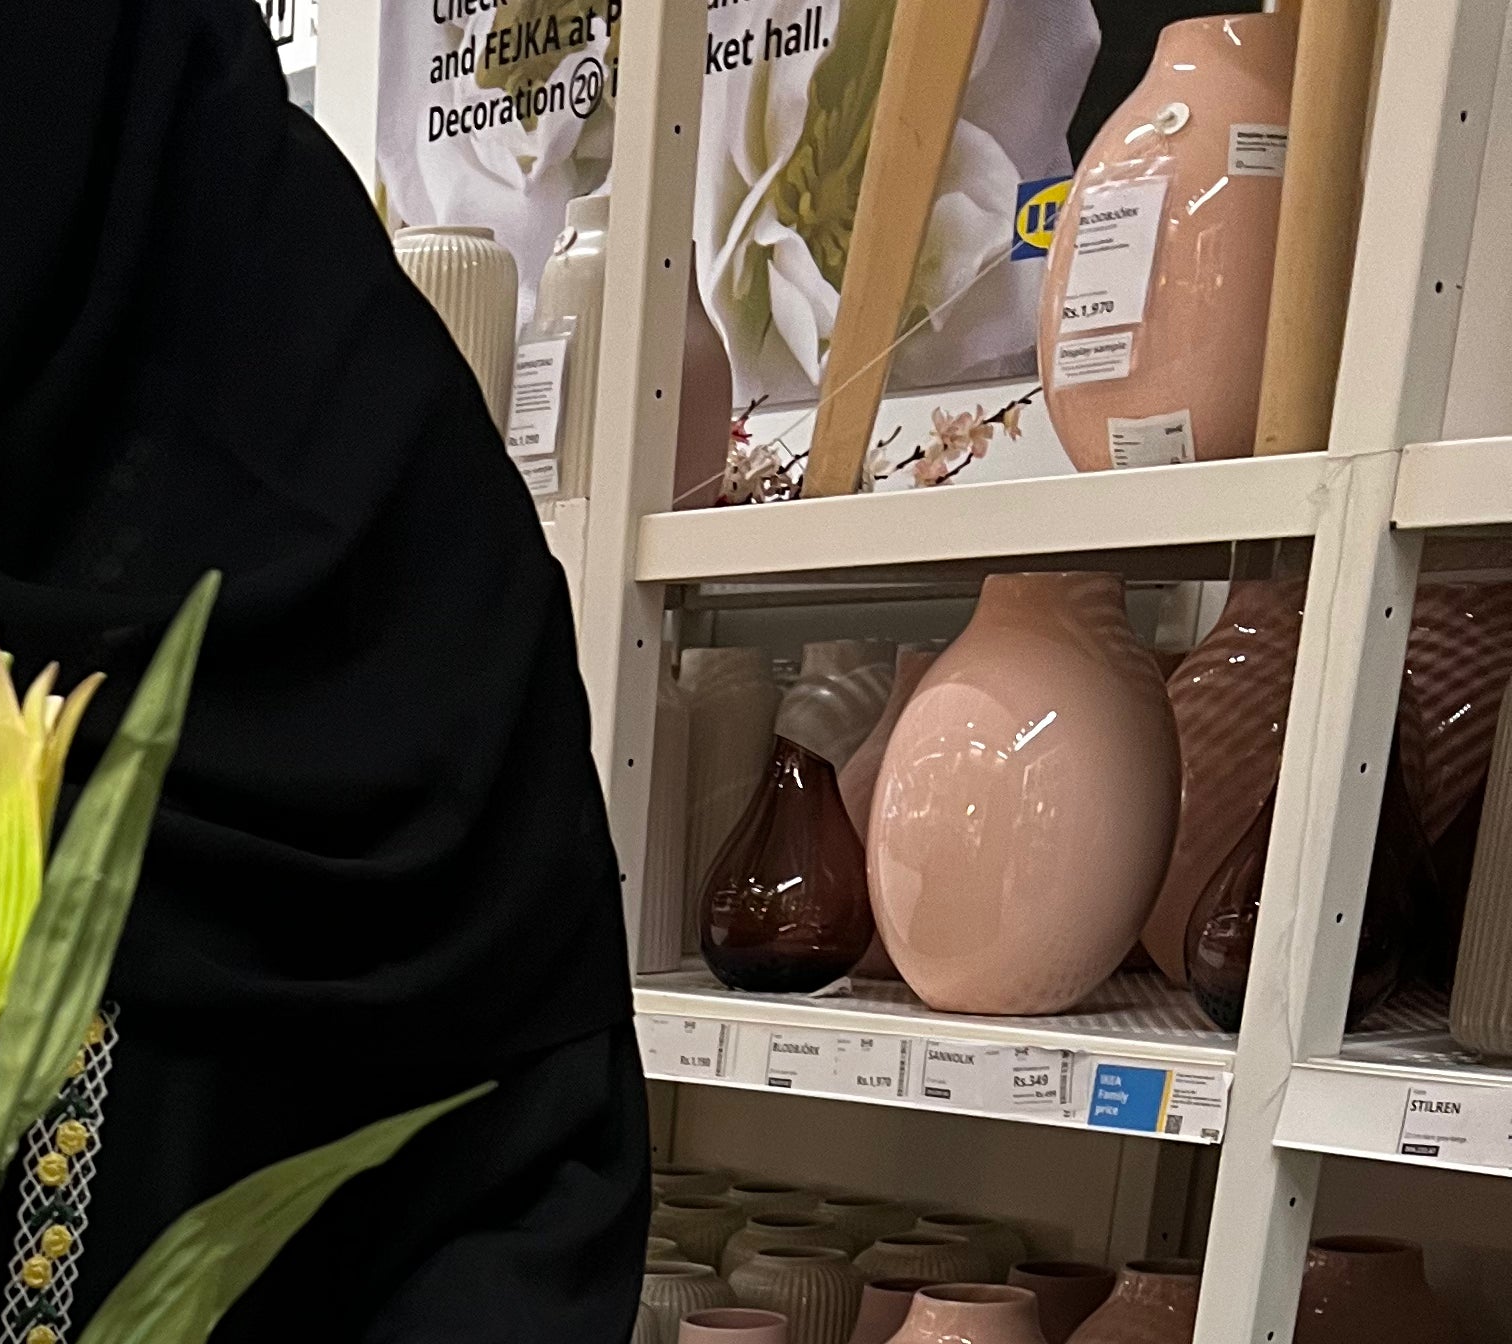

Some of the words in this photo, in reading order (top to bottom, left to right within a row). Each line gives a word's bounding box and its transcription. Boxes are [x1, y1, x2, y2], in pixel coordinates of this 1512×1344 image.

[433, 0, 508, 24] Che
[430, 35, 475, 84] and
[485, 15, 560, 69] FEJKA
[569, 6, 595, 46] at
[429, 79, 564, 142] Decoration
[611, 58, 619, 98] i
[705, 29, 754, 74] ket
[764, 6, 829, 61] hall.
[1014, 1074, 1049, 1087] Rs.349
[1410, 1099, 1461, 1114] STILREN
